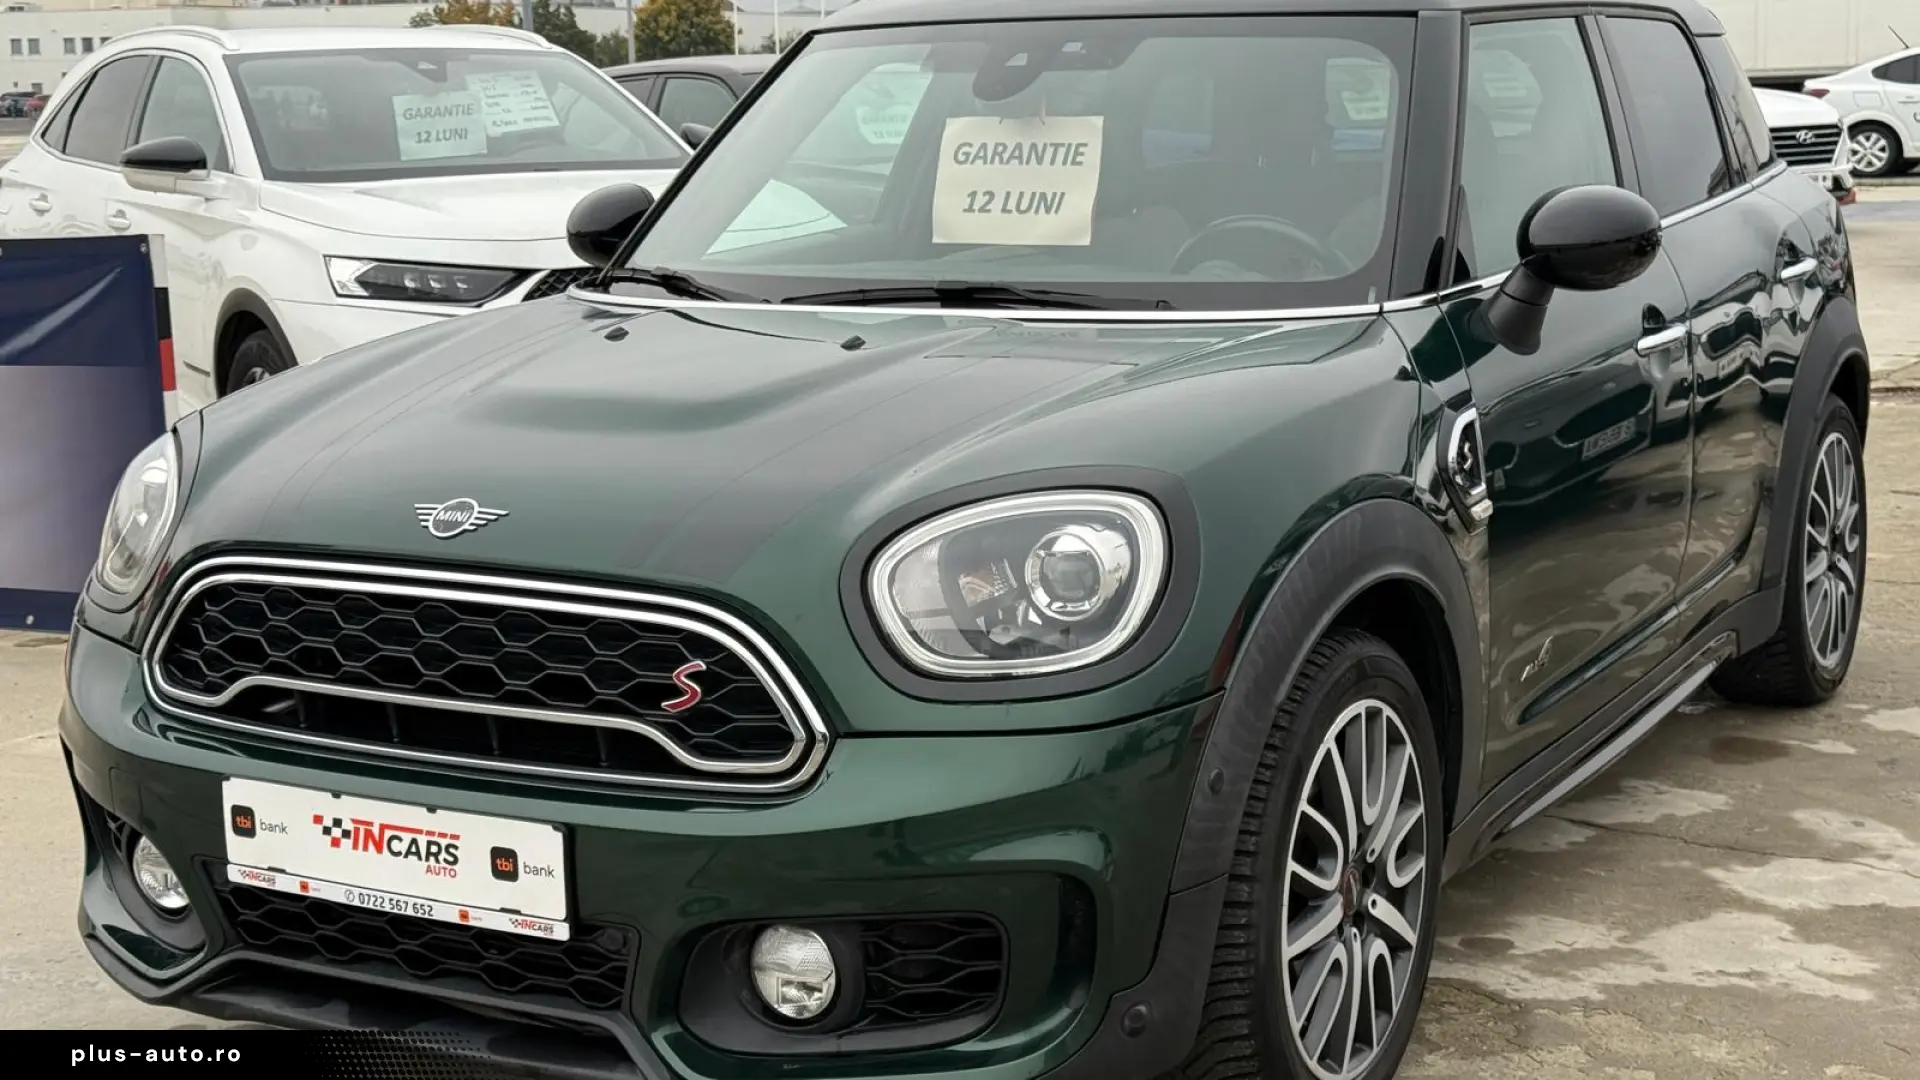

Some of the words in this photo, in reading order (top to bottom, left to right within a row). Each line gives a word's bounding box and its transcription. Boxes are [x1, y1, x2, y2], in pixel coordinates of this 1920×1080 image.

[403, 103, 475, 121] GARANTIE
[414, 131, 432, 144] 12
[436, 128, 468, 142] LUNI
[953, 142, 1088, 166] GARANTIE
[962, 190, 996, 214] 12
[1000, 191, 1066, 215] LUNI
[436, 510, 471, 523] MINI
[661, 660, 707, 713] S
[235, 814, 252, 829] tbi
[259, 818, 289, 835] bank
[351, 818, 460, 867] INCARS
[425, 864, 457, 879] AUTO
[495, 857, 514, 872] tbi
[523, 861, 555, 879] bank
[358, 892, 386, 909] 0722
[389, 899, 408, 912] 567
[412, 903, 434, 918] 652
